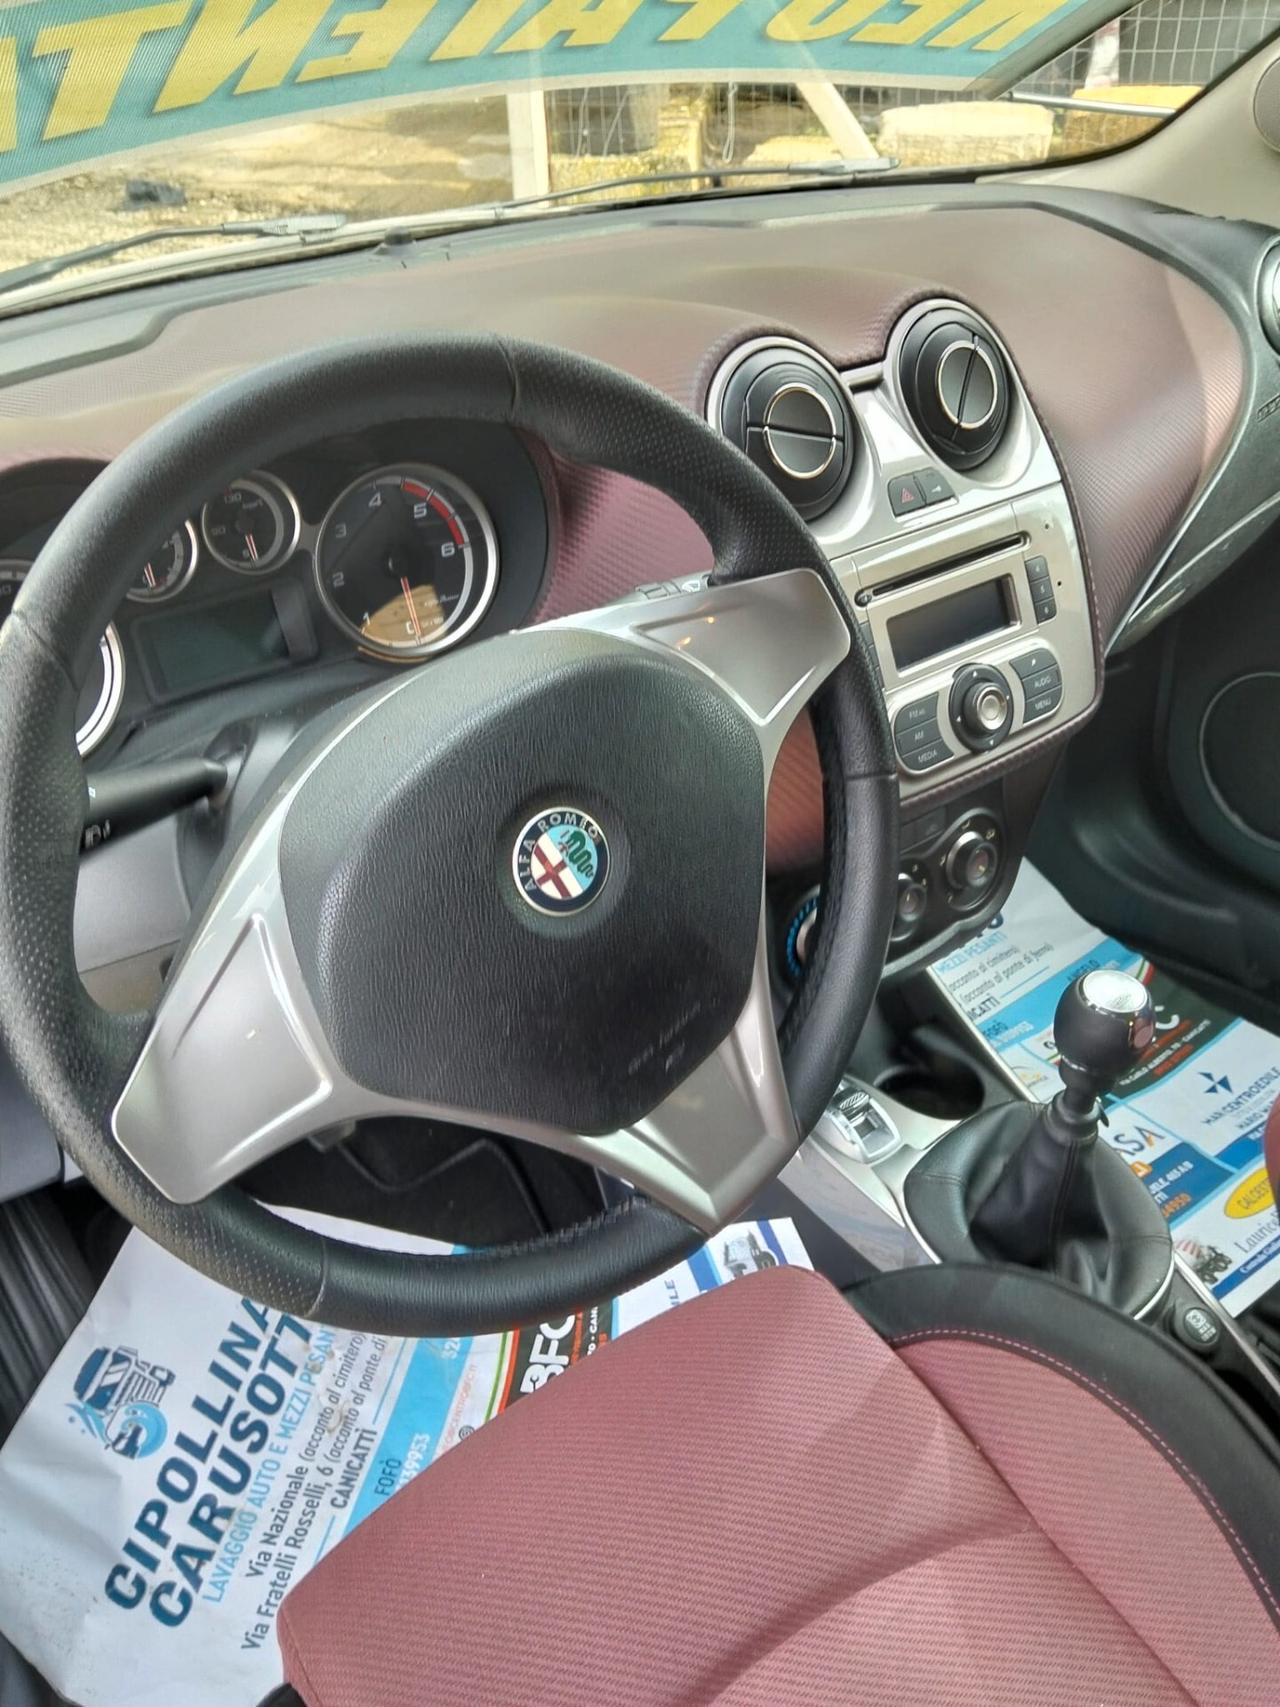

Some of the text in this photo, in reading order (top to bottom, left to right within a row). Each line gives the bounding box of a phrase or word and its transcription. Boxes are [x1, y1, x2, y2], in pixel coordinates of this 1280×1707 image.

[368, 492, 382, 507] 4
[413, 503, 428, 518] 5
[335, 523, 347, 538] 3
[441, 542, 456, 557] 6
[332, 571, 345, 588] 2
[1034, 677, 1052, 689] AUDIO
[1034, 700, 1052, 711] MENU
[918, 750, 937, 763] MEDIA
[518, 812, 599, 892] ALFA ROMEO
[520, 1314, 575, 1393] BFC
[276, 1388, 312, 1439] MEZZI
[269, 1441, 288, 1456] E
[331, 1427, 378, 1510] CANICATTÌ
[374, 1457, 401, 1497] FOFÒ
[241, 1336, 387, 1650] Via Fratelli Rosselli, 6 (accanto al ponte di
[246, 1550, 272, 1578] Via
[260, 1465, 309, 1546] Nazionale
[299, 1407, 334, 1462] (accanto
[327, 1388, 342, 1407] al
[247, 1458, 281, 1509] AUTO
[202, 1509, 258, 1603] LAVAGGIO
